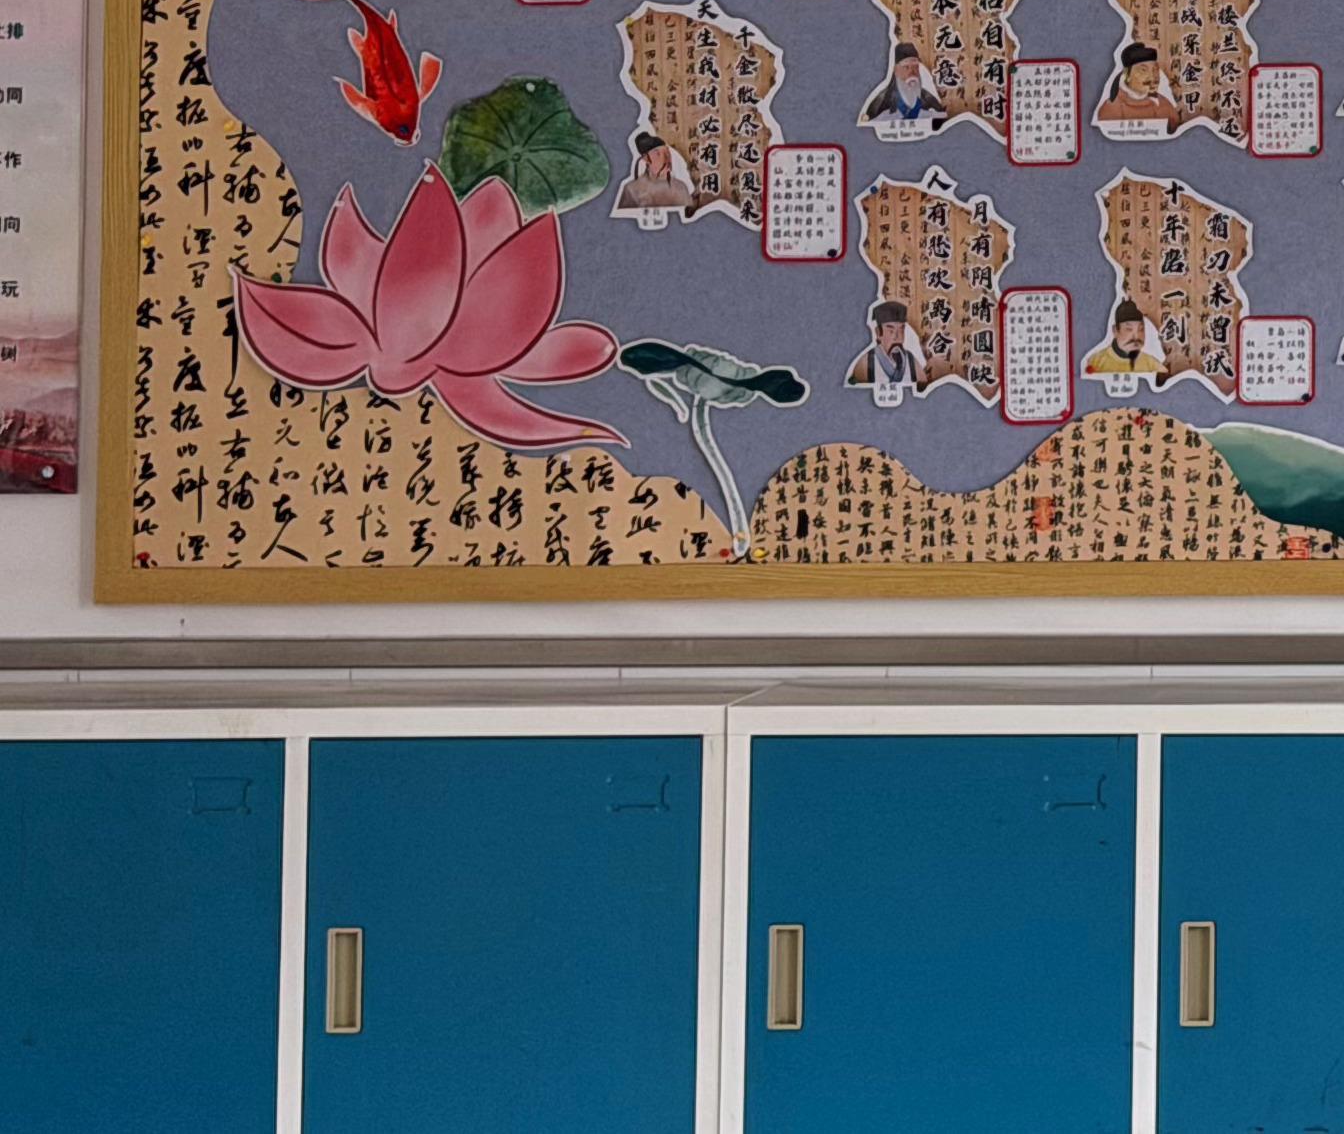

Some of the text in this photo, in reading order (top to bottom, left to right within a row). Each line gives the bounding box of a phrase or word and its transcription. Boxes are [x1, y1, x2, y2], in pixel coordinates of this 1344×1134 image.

[697, 0, 720, 195] 天生我材必有用
[735, 26, 761, 223] 千金散尽还复来
[927, 171, 953, 355] 人有悲欢离合
[1161, 181, 1186, 344] 十年磨一剑
[1204, 213, 1234, 378] 霜刃未曾试
